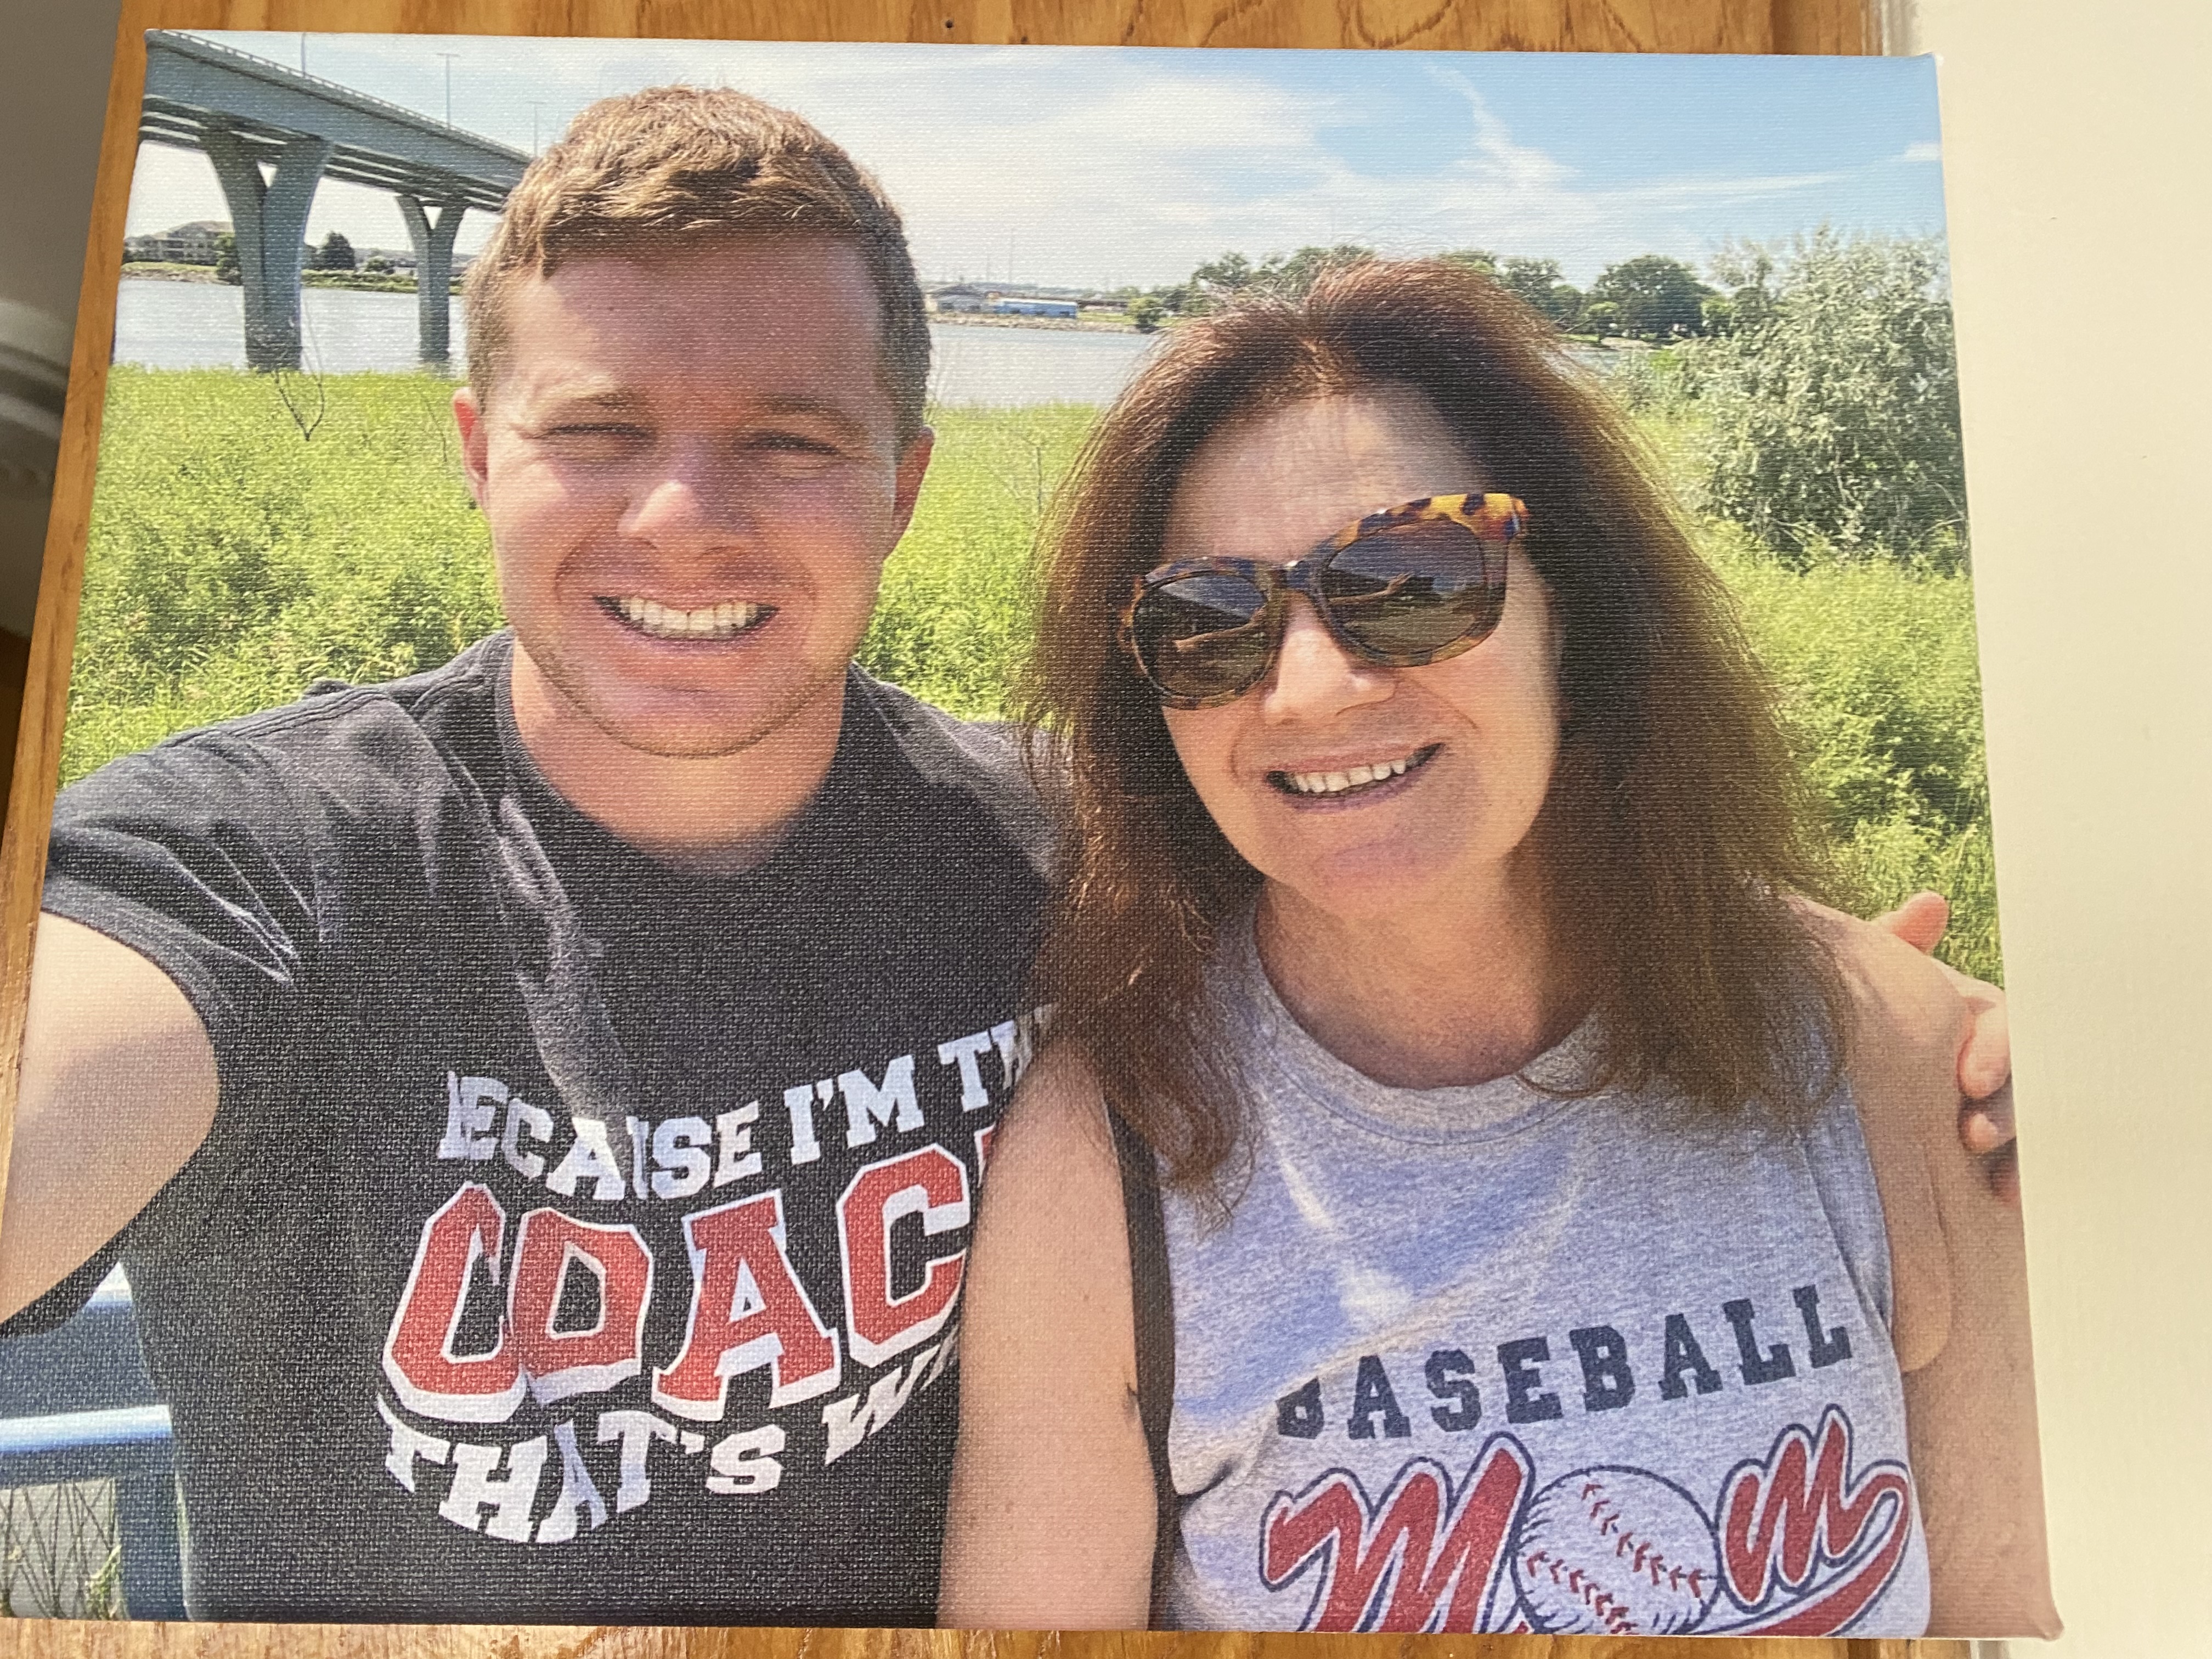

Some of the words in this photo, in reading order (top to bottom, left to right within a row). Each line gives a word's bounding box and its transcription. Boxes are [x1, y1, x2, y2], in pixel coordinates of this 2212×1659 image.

[783, 1054, 926, 1166] I'M
[382, 1124, 996, 1423] COAC
[377, 1389, 787, 1544] THAT'S
